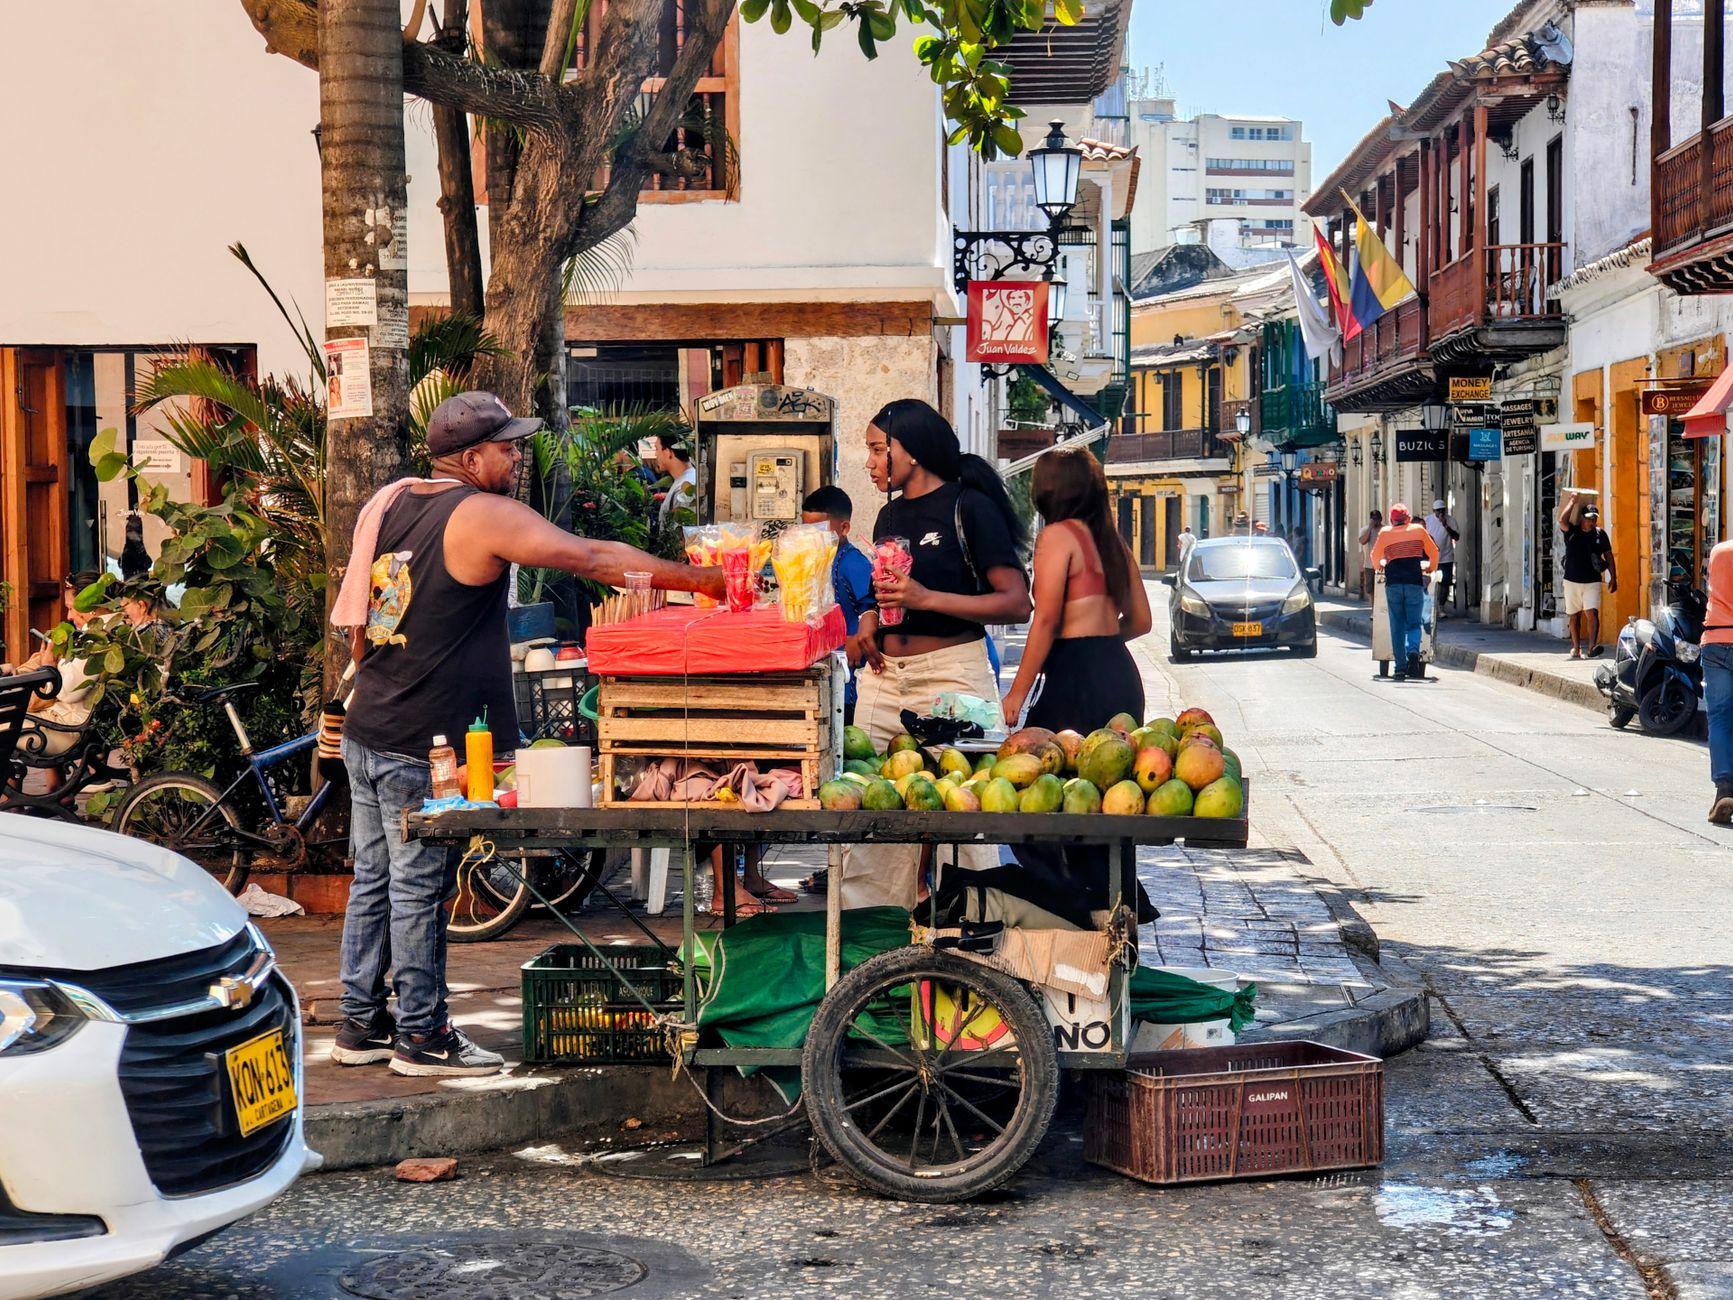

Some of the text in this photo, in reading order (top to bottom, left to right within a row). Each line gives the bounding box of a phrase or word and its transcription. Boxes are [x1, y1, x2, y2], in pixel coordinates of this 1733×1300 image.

[977, 342, 1037, 354] Juan Valdez
[1452, 379, 1488, 388] MONEY
[1451, 390, 1489, 399] EXCHANGE
[1501, 403, 1532, 412] MASSAGES
[1503, 416, 1534, 426] JEWELRY
[1513, 444, 1535, 452] TURISMO
[1054, 1021, 1110, 1050] NO
[1248, 1091, 1288, 1102] GALIPAN
